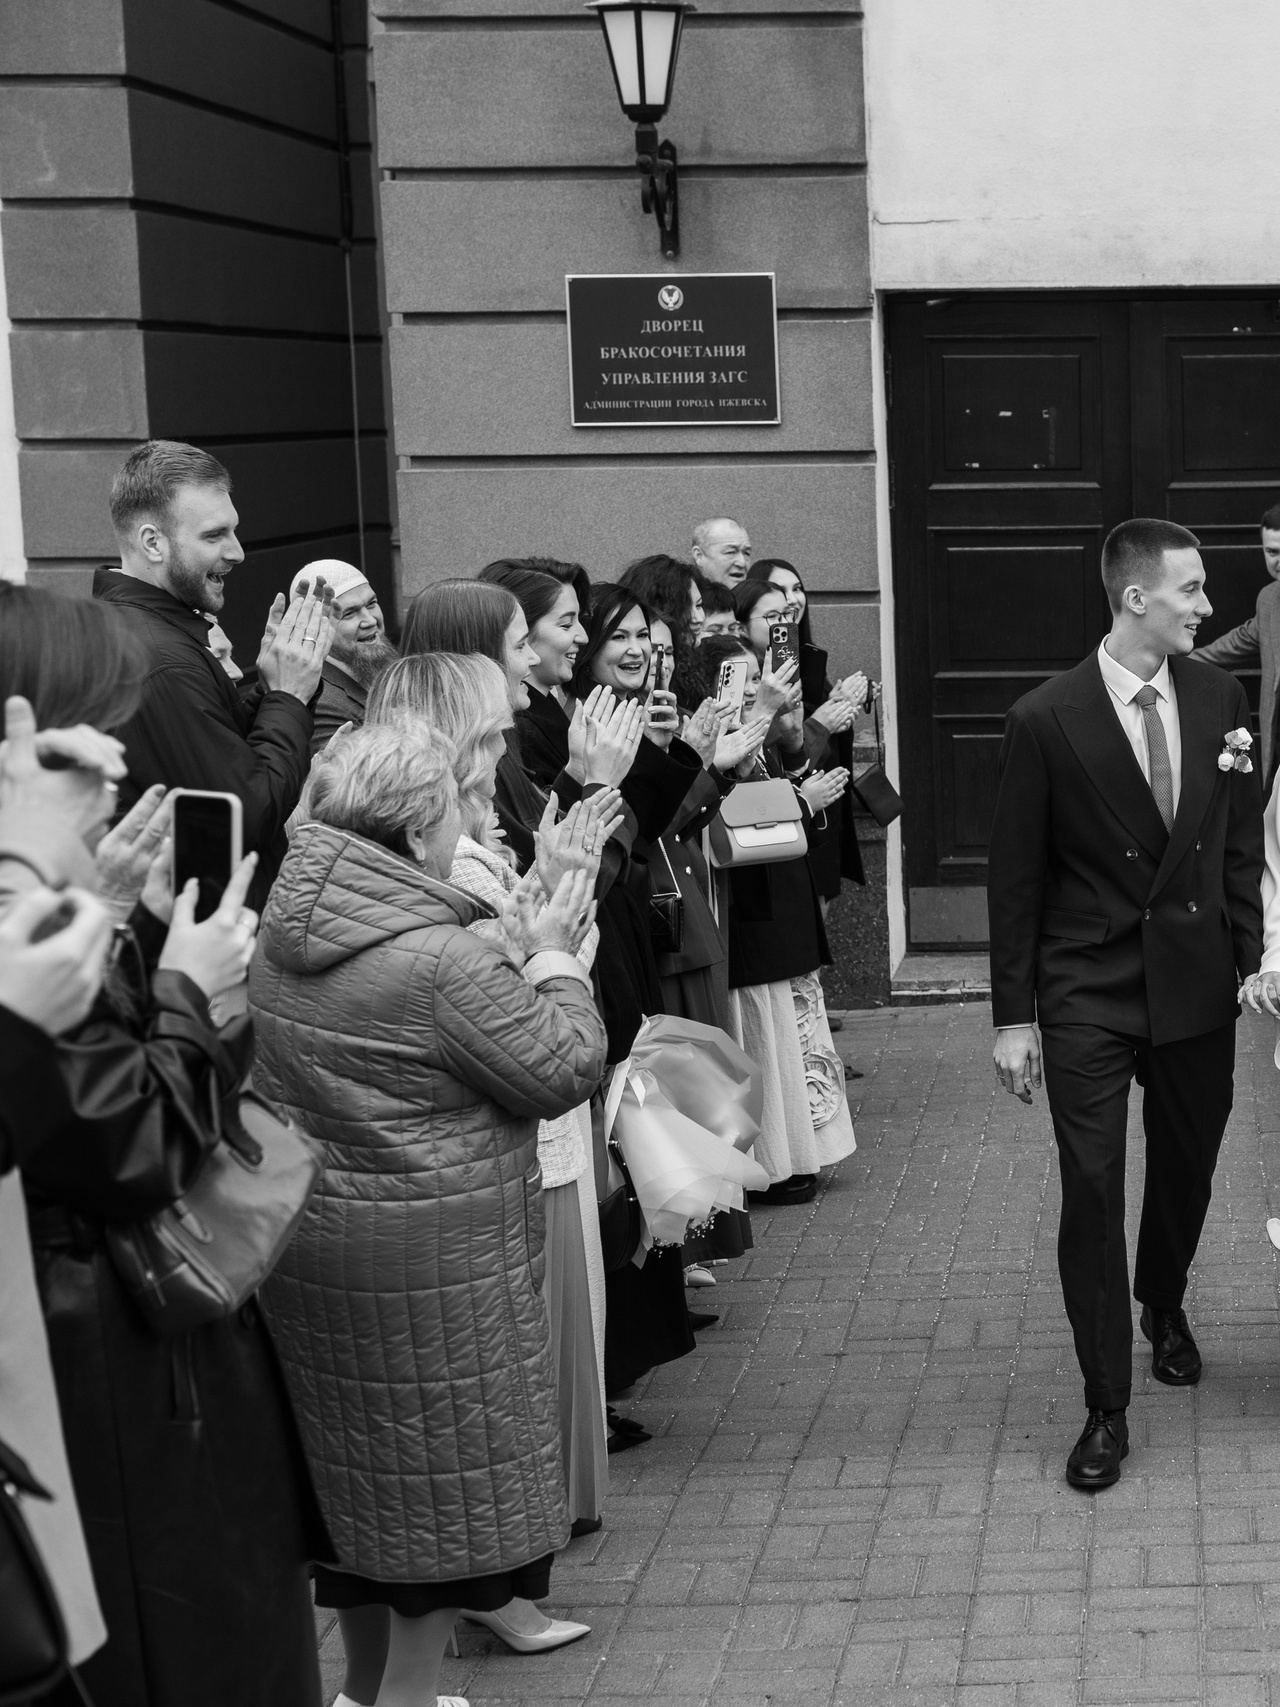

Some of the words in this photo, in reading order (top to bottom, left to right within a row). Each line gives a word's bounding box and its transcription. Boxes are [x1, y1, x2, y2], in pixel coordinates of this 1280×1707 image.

[640, 319, 704, 334] ДВОРЕЦ
[600, 345, 746, 359] БРАКОСОЧЕТАНИЯ
[600, 371, 705, 386] УПРАВЛЕНИЯ
[708, 370, 748, 384] ЗАГС
[583, 400, 672, 410] АДМИНИСТРАЦИИ
[676, 398, 715, 408] ГОРОДА
[718, 398, 767, 408] ИЖЕВСКА
